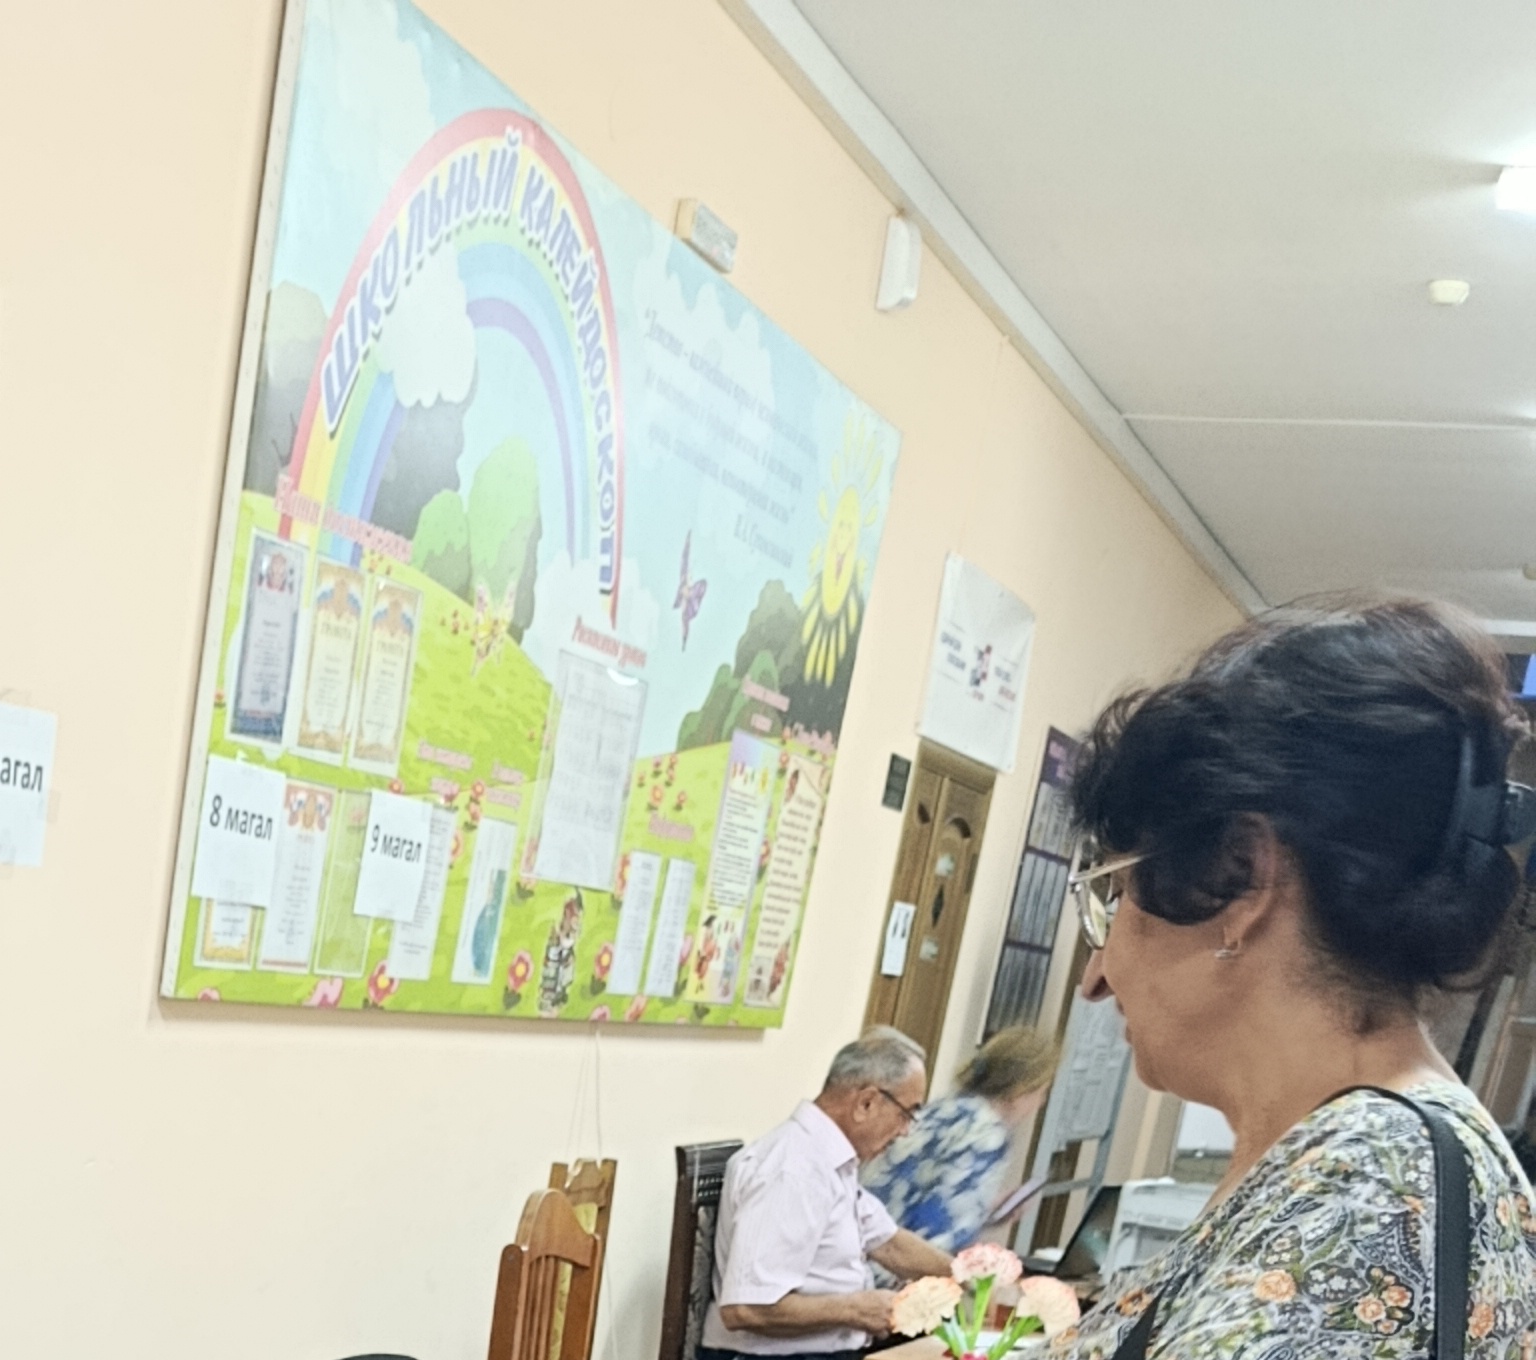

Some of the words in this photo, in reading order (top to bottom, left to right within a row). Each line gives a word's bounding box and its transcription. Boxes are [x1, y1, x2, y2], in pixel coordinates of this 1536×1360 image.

[322, 130, 520, 428] ШКОЛЬНЫЙ
[520, 165, 615, 586] КАЛЕЙДОСКОП
[209, 794, 223, 828] 8
[224, 806, 274, 841] магал
[370, 824, 381, 854] 9
[381, 833, 422, 863] магал
